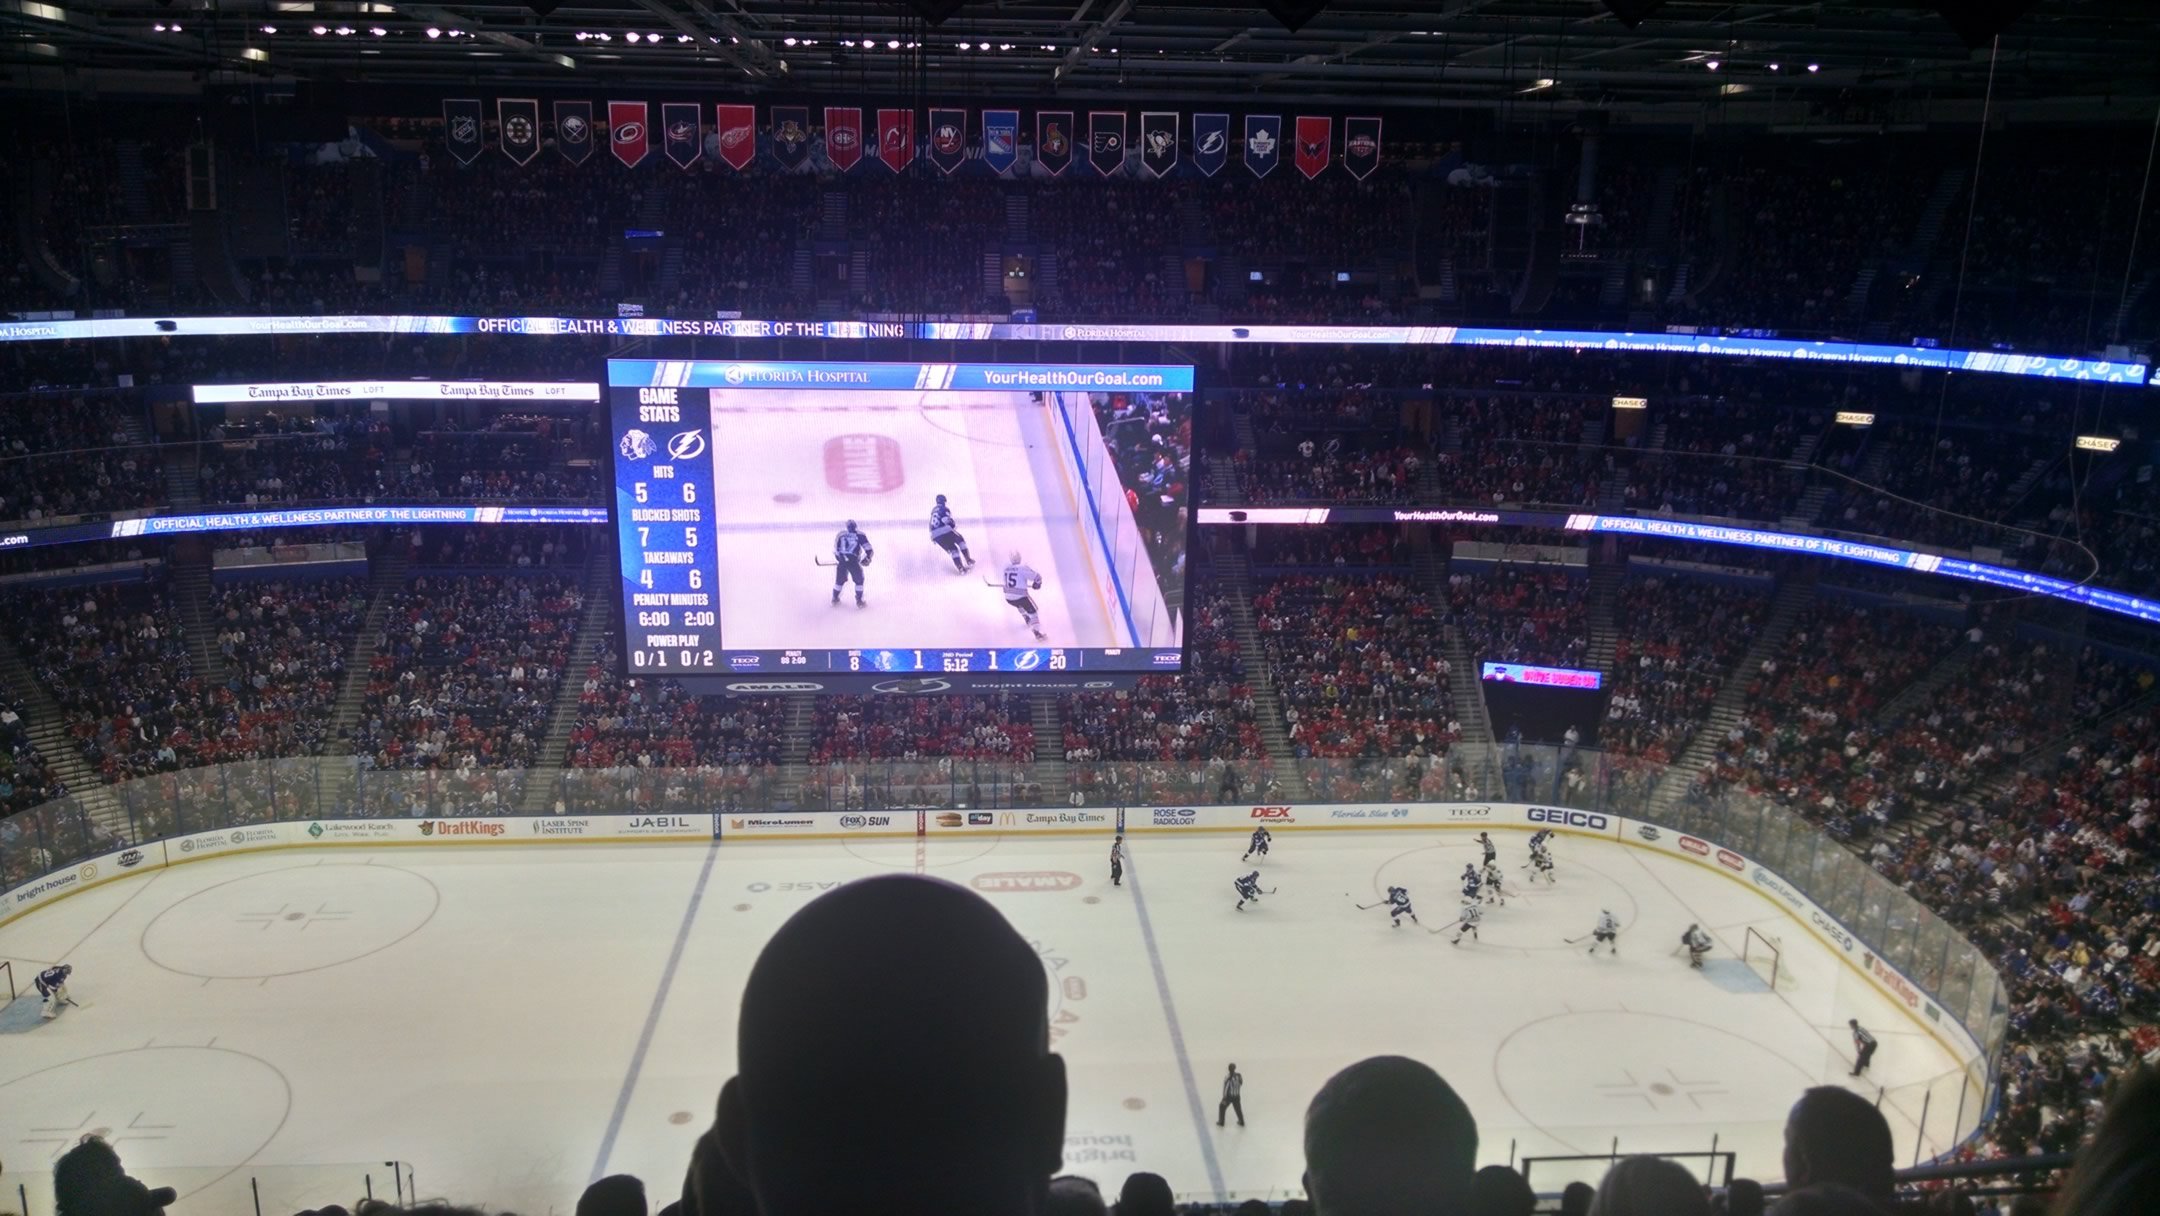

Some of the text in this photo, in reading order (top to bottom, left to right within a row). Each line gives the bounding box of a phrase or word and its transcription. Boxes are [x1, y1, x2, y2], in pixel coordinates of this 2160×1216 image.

[478, 317, 904, 337] OFFICIAL HEALTH & WELLNESS PARTNER OF THE LIGHTNING
[807, 370, 870, 383] HOSPITAL
[984, 370, 1162, 385] YourHealthOurGoal.com
[249, 385, 351, 401] Tampa Bay Times
[363, 386, 385, 394] LOFT
[440, 384, 534, 399] Tampa Bay Times
[545, 387, 565, 395] LOFT
[639, 388, 678, 405] GAME
[639, 406, 680, 422] STATS
[653, 465, 674, 478] HITS
[635, 483, 695, 502] 5 6
[153, 509, 466, 530] OFFICIAL HEALTH & WELLNESS PARTNER OF THE LIGHTNING
[632, 509, 700, 521] BLOCKED SHOTS
[1394, 511, 1499, 523] YourHealthOurGoal.com
[638, 528, 697, 547] 7 5
[1601, 519, 1900, 563] OFFICIAL HEALTH & WELLNESS PARTNER OF THE LIGHTNING
[643, 552, 694, 564] TAKEAWAYS
[640, 569, 701, 589] 4 6
[633, 593, 708, 606] PENALTY MINUTES
[639, 611, 714, 626] 6:00 2:00
[647, 635, 699, 647] POWER PLAY
[850, 657, 860, 671] 8
[914, 650, 924, 669] 1
[943, 658, 968, 672] 5:12
[988, 651, 998, 669] 1
[1050, 656, 1066, 670] 20
[1026, 812, 1105, 826] Tampa Bay Times
[1154, 809, 1176, 817] ROSE
[1251, 807, 1292, 818] DEX
[1527, 808, 1607, 830] GEICO
[542, 820, 565, 828] LASER
[630, 817, 689, 828] JABIL
[845, 816, 890, 826] FOX SUN
[438, 821, 505, 836] DraftKings
[17, 885, 45, 902] bright
[46, 873, 77, 890] house
[1065, 1149, 1136, 1164] brigh
